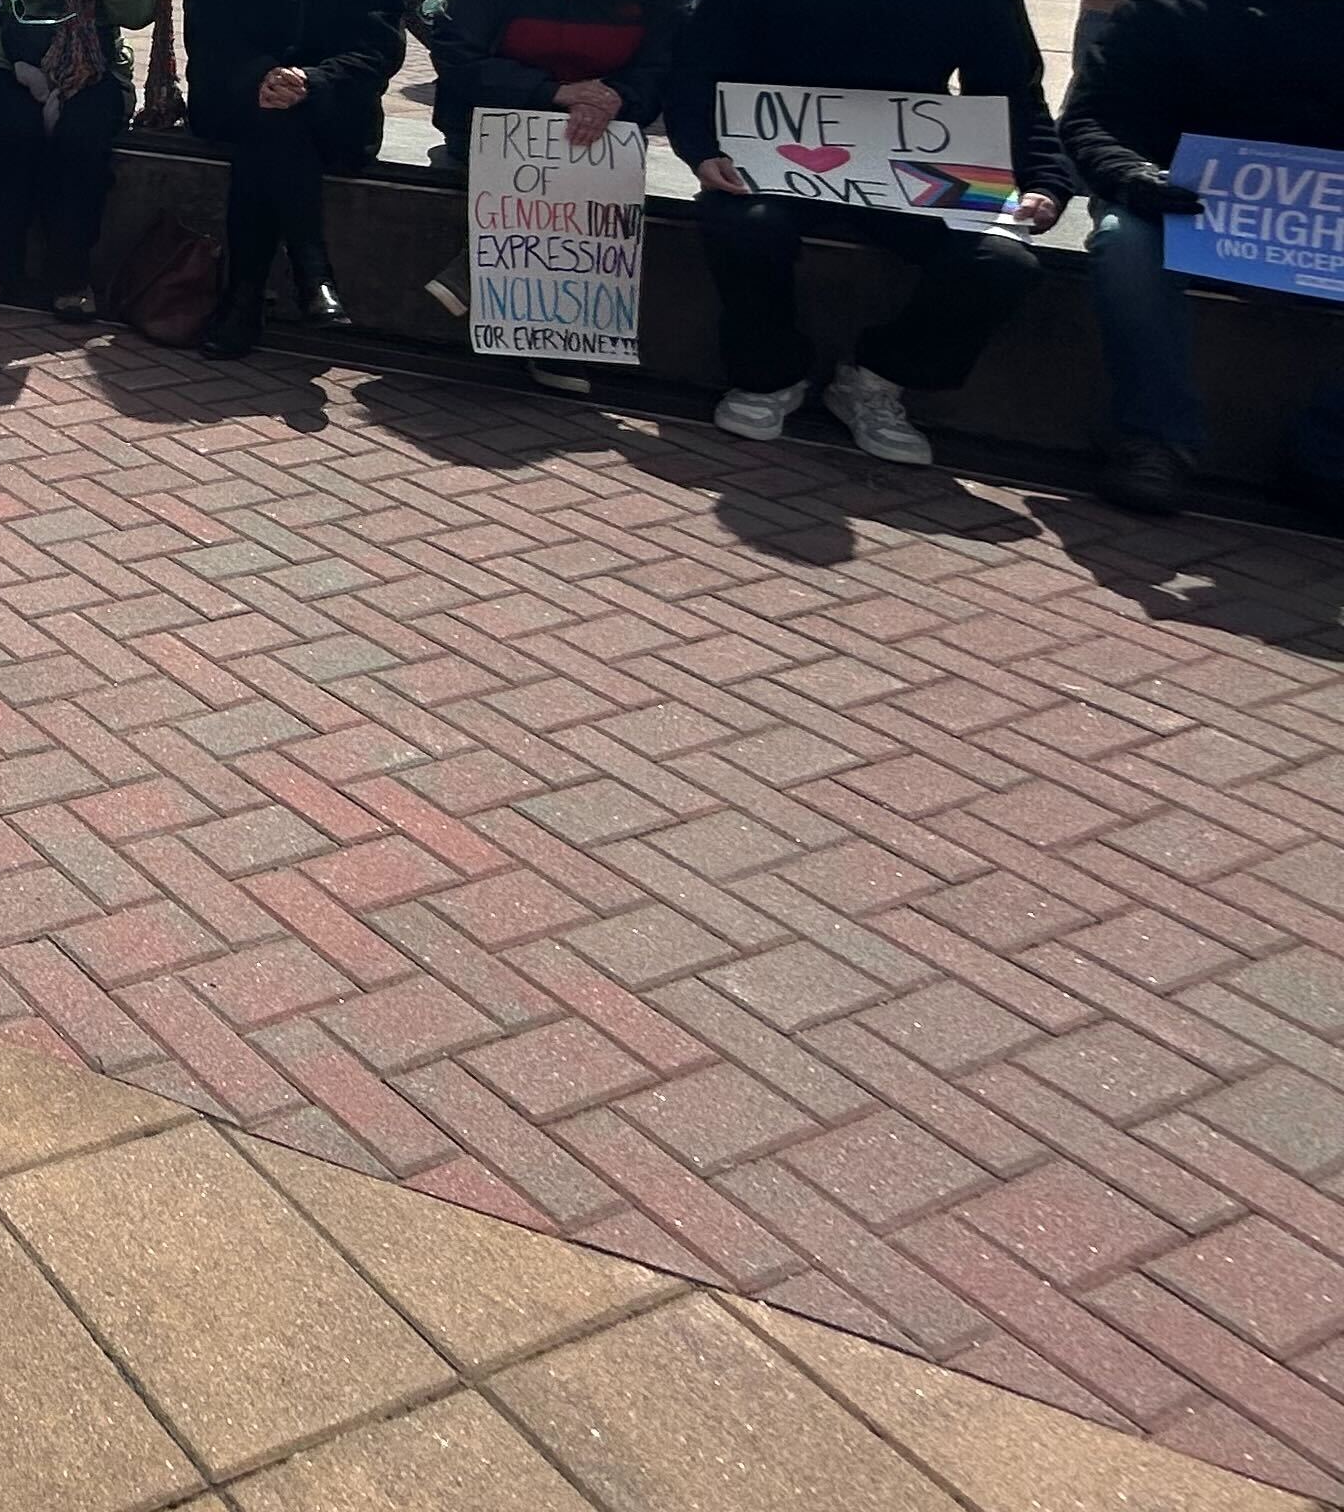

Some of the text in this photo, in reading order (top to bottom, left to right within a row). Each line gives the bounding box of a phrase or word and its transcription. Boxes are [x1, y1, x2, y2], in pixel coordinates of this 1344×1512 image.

[718, 89, 951, 155] LOVE IS
[513, 163, 561, 196] OF
[735, 166, 904, 211] LOVE
[1197, 158, 1344, 213] LOVE
[474, 190, 585, 236] GENDER
[477, 234, 640, 279] EXPRESSION
[1216, 238, 1258, 260] (NO
[478, 275, 637, 331] INCLUSION
[474, 324, 510, 350] FOR
